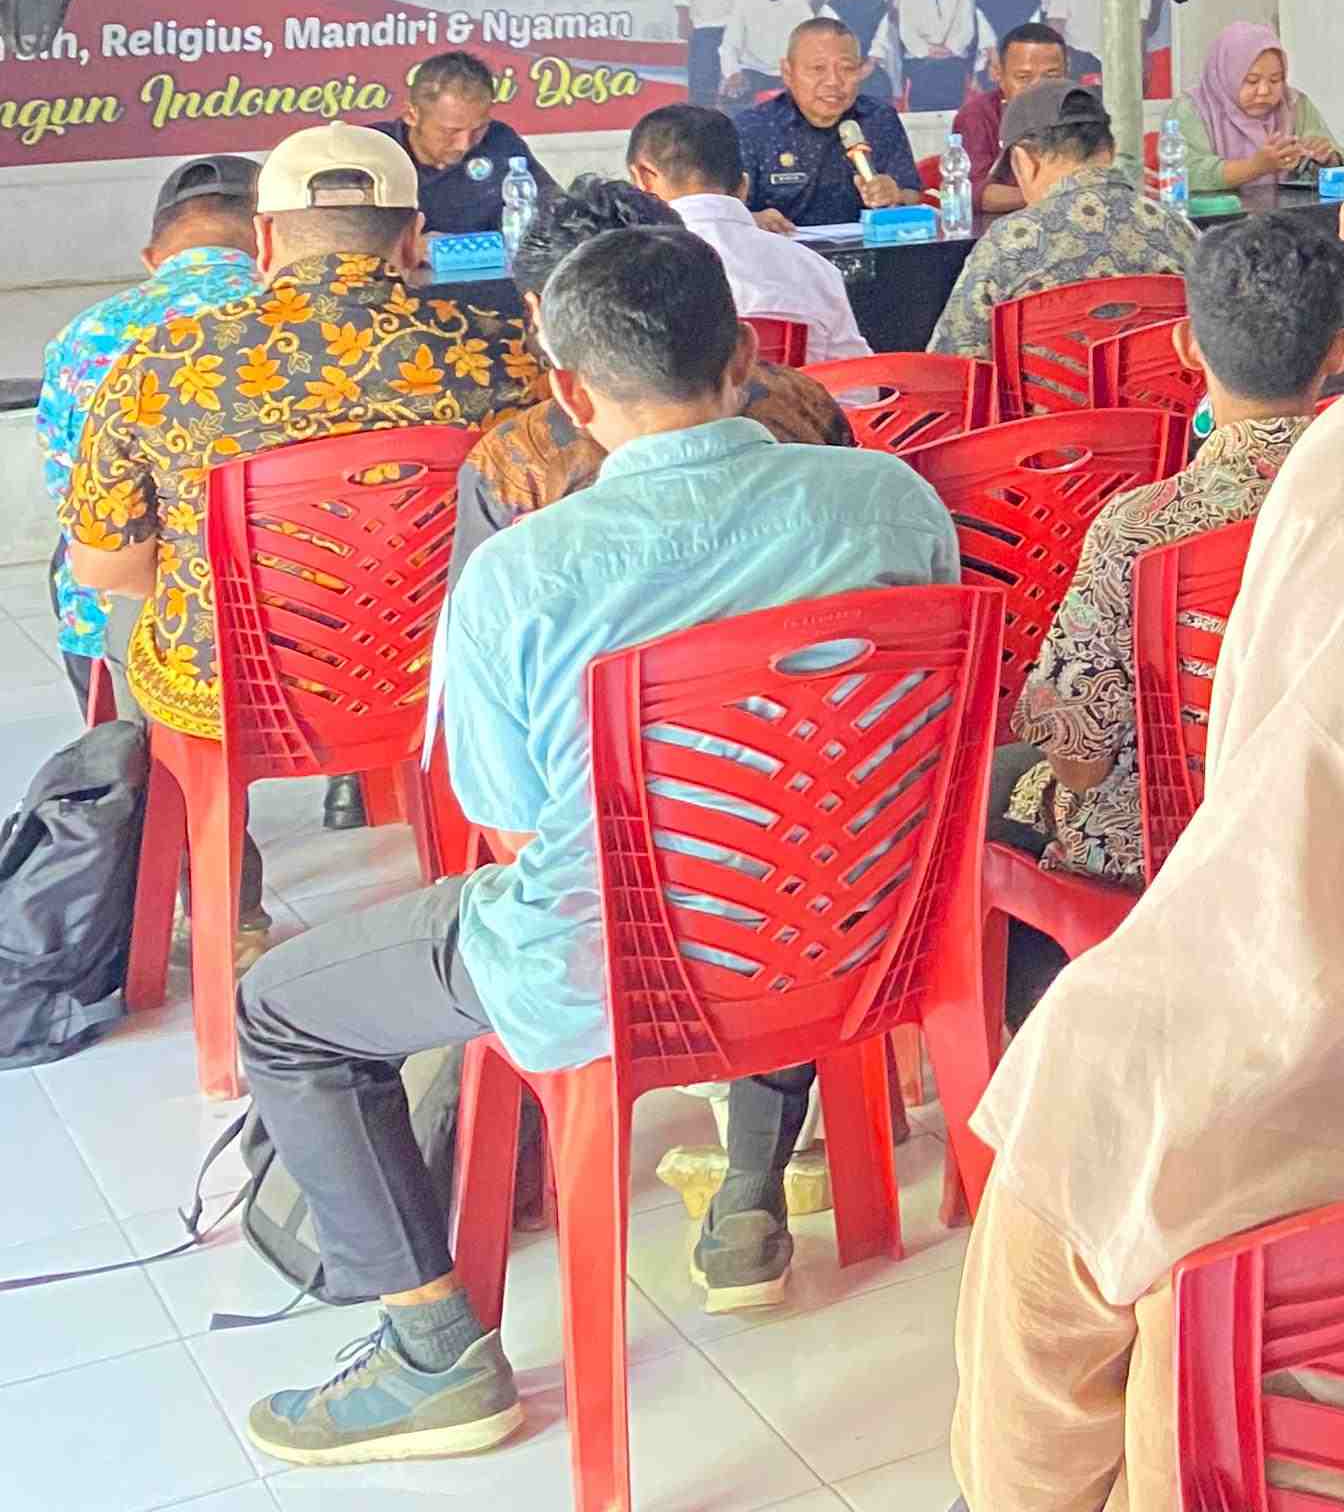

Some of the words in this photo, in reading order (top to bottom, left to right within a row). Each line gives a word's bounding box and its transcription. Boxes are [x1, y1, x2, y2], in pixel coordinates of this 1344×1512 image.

[102, 18, 273, 62] Religius,
[285, 12, 438, 49] Mandiri
[446, 11, 474, 44] &
[481, 9, 632, 47] Nyaman
[141, 72, 392, 129] Indonesia
[529, 55, 641, 107] Desa
